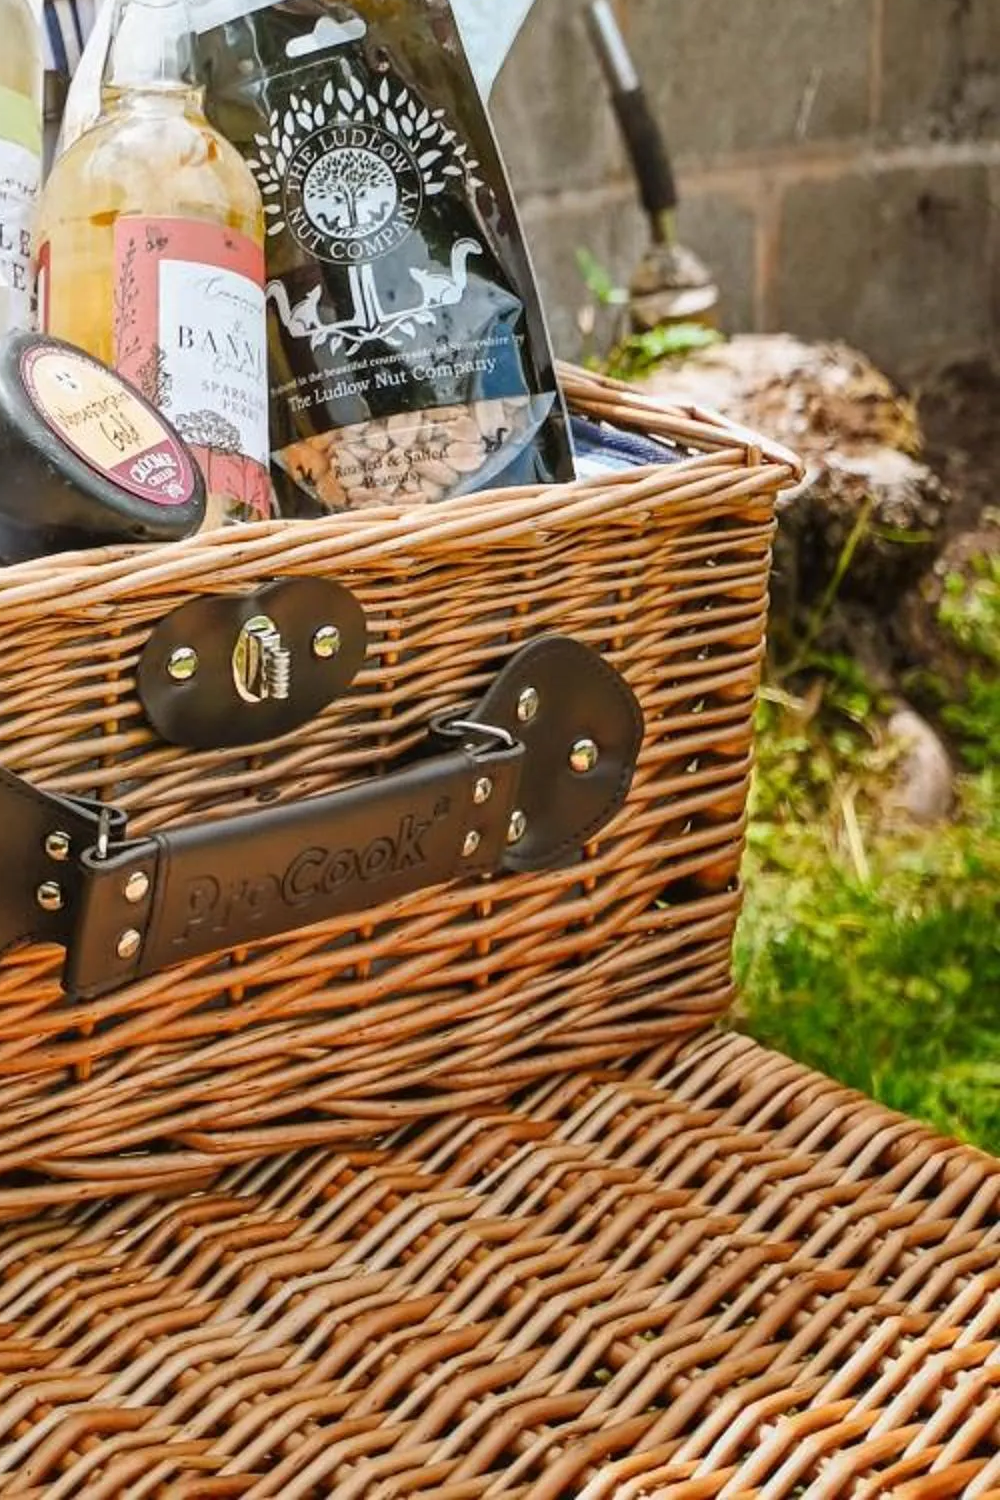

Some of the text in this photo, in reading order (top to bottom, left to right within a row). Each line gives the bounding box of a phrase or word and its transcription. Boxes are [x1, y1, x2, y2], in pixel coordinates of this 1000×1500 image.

[286, 128, 412, 195] THE LUDLOW
[288, 187, 419, 259] NUT COMPANY
[287, 394, 312, 413] The
[314, 379, 371, 405] Ludlow
[373, 370, 408, 389] Nut
[411, 356, 498, 381] Company
